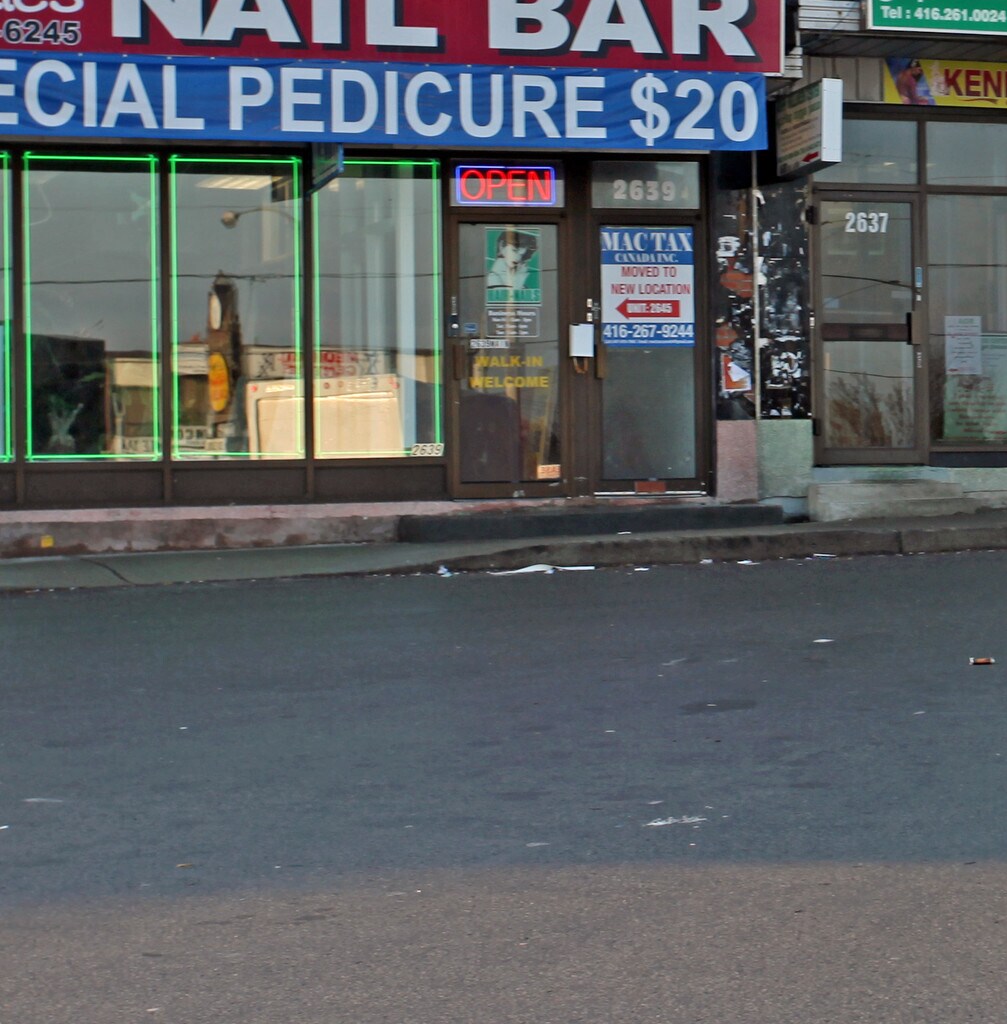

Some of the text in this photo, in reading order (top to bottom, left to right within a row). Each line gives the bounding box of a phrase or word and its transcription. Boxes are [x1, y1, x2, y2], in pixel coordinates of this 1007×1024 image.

[880, 5, 903, 19] Tel
[914, 7, 1007, 22] 416.261.0024
[229, 65, 607, 139] PEDICURE
[629, 73, 759, 146] $20
[460, 169, 550, 201] OPEN
[613, 179, 676, 201] 2639
[844, 212, 889, 234] 2637
[601, 232, 693, 252] MAC TAX
[614, 253, 679, 263] CANADA INC.
[621, 266, 677, 277] MOVED TO
[611, 283, 691, 294] NEW LOCATION
[603, 324, 694, 338] 416-267-9244
[474, 356, 543, 367] WALK-IN
[469, 376, 549, 388] WELCOME
[412, 445, 443, 456] 2639
